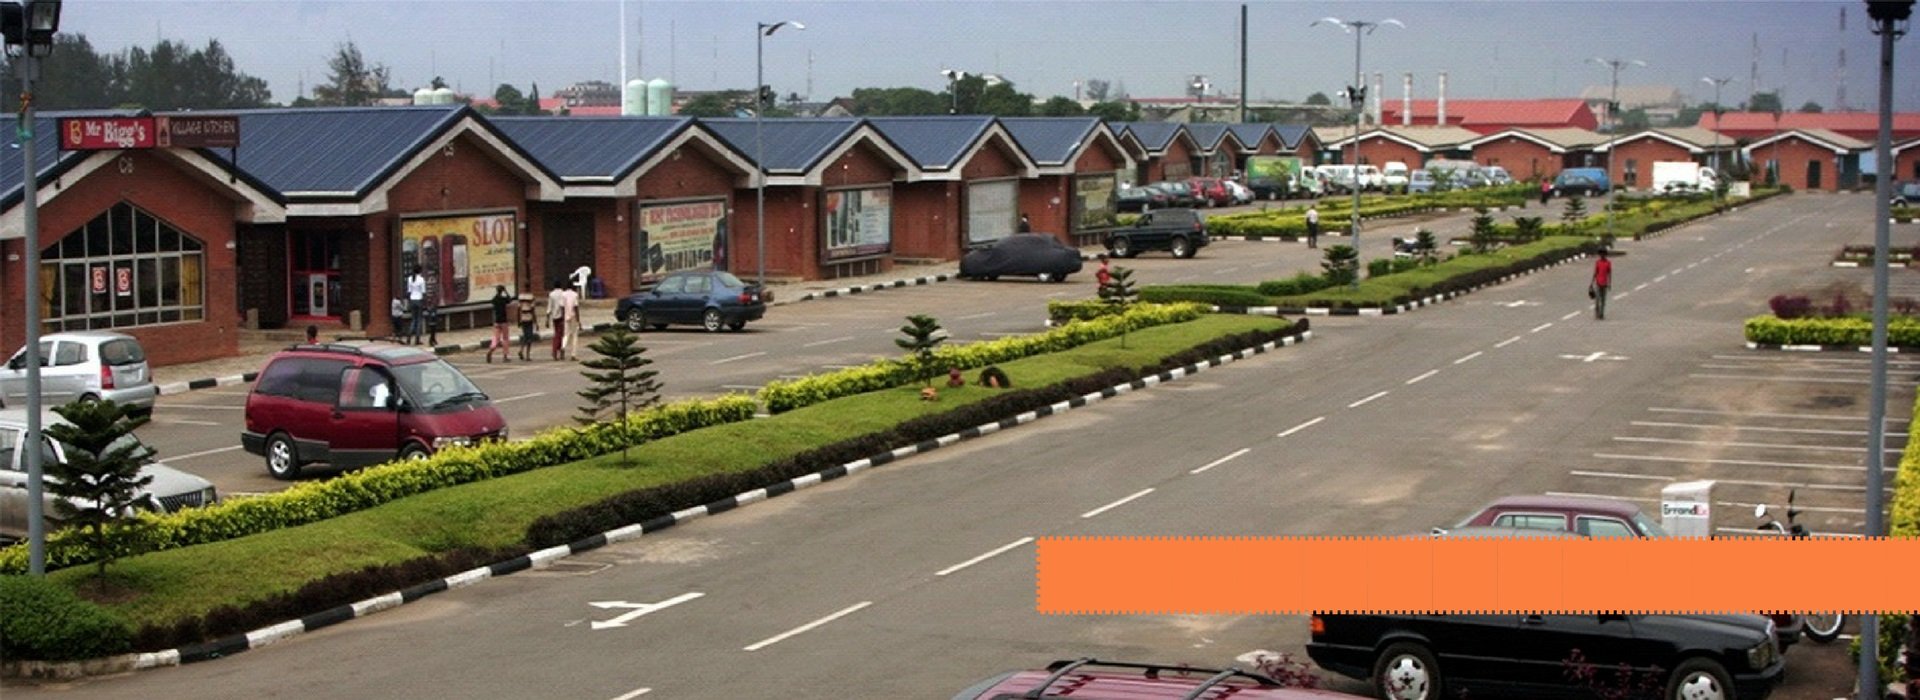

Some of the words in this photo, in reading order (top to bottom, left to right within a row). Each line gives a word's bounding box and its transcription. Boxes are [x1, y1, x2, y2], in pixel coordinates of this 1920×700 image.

[85, 121, 101, 136] Mr
[104, 121, 145, 148] Bigg's
[472, 217, 514, 247] SLOT
